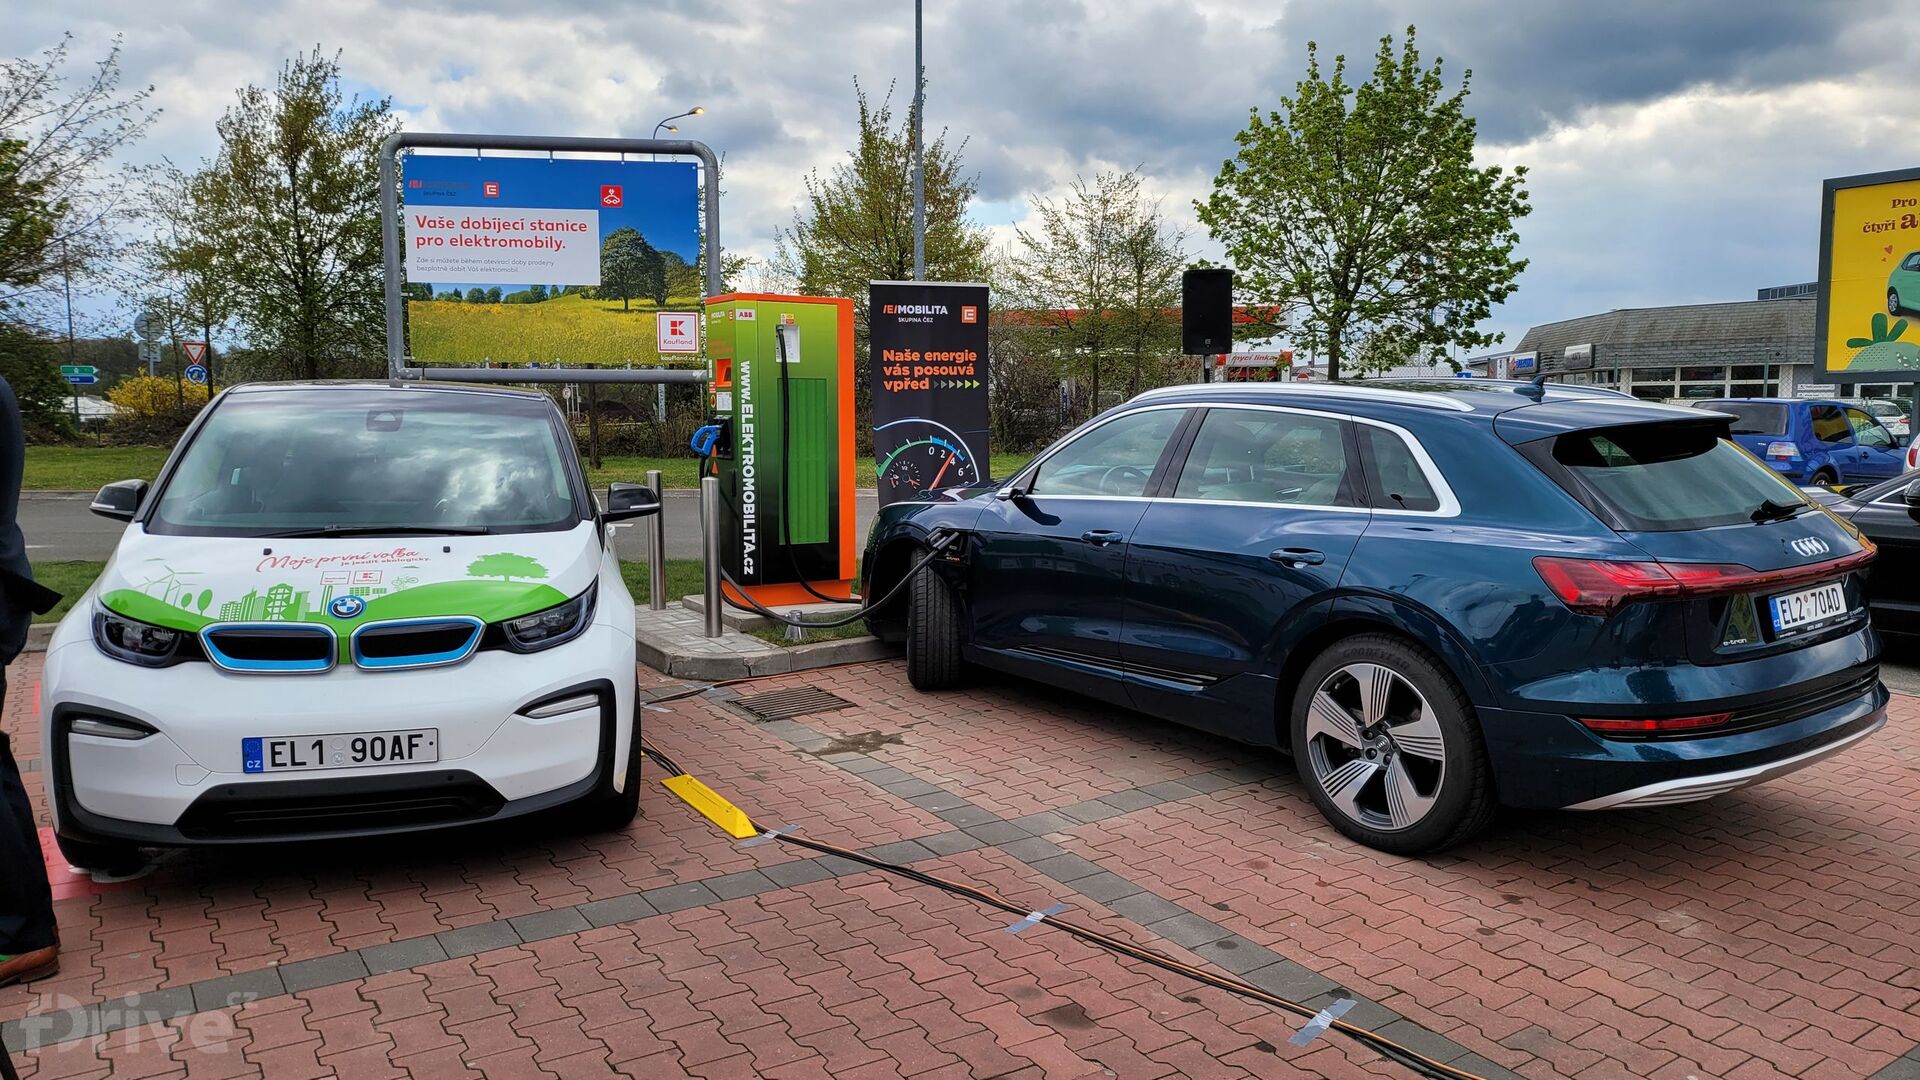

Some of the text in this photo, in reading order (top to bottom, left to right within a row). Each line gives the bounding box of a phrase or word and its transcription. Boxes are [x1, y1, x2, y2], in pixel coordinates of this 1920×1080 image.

[416, 215, 587, 233] Vaše dobíjecí stanice
[1863, 220, 1896, 233] čtyři
[416, 233, 565, 252] pro elektromobily.
[883, 349, 977, 363] Naše energie
[883, 363, 974, 377] vás posouvá
[884, 378, 929, 392] vpřed
[929, 447, 934, 455] 0
[941, 450, 945, 458] 2
[950, 457, 956, 465] 4
[958, 468, 964, 476] 6
[256, 547, 419, 572] Moje první volba
[1780, 587, 1840, 625] EL2 70AD
[1723, 638, 1747, 646] e-tron
[270, 734, 423, 767] EL1 90AF
[246, 760, 261, 768] CZ
